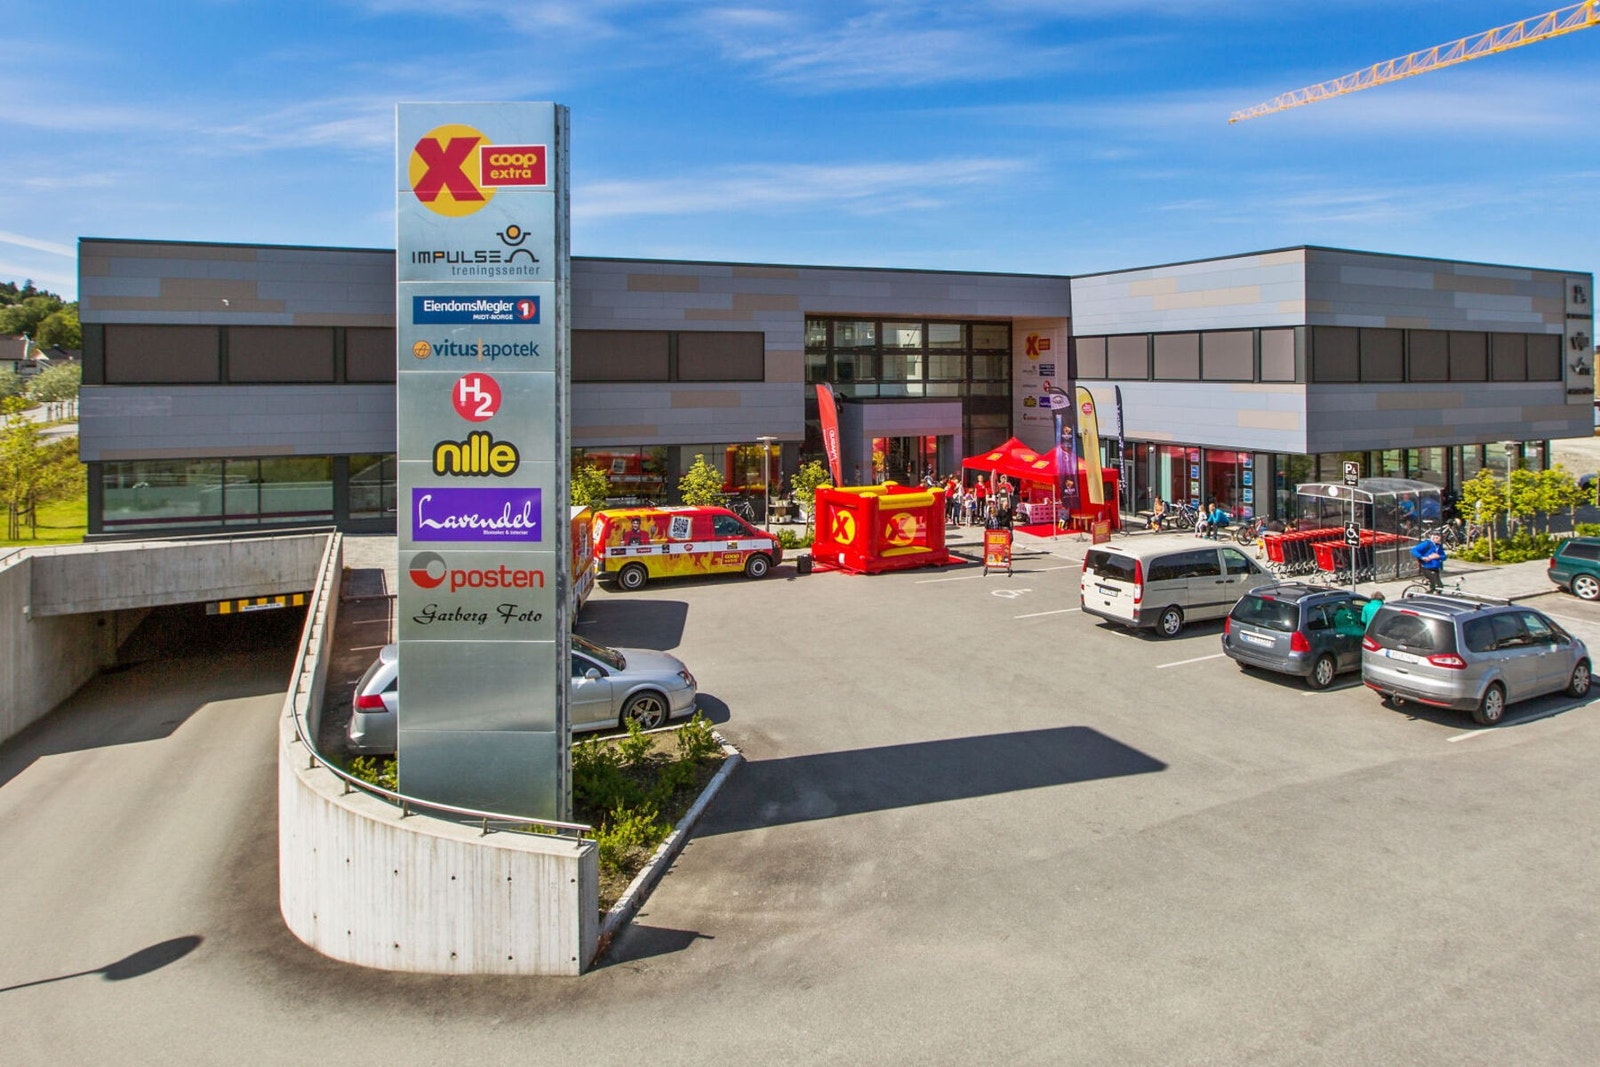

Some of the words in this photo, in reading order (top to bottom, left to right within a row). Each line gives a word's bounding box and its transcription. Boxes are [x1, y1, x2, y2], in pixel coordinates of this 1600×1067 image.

[413, 136, 486, 202] X
[489, 153, 538, 168] coop
[490, 168, 532, 179] extra
[412, 251, 501, 264] IMPULSE
[451, 265, 541, 277] treningssenter
[423, 300, 514, 312] EiendomsMegler
[459, 378, 494, 417] H2
[435, 433, 518, 475] nille
[1345, 463, 1352, 474] P
[418, 494, 537, 530] Lavendel
[450, 564, 545, 592] posten
[412, 604, 488, 625] Garberg
[496, 603, 543, 624] Foto
